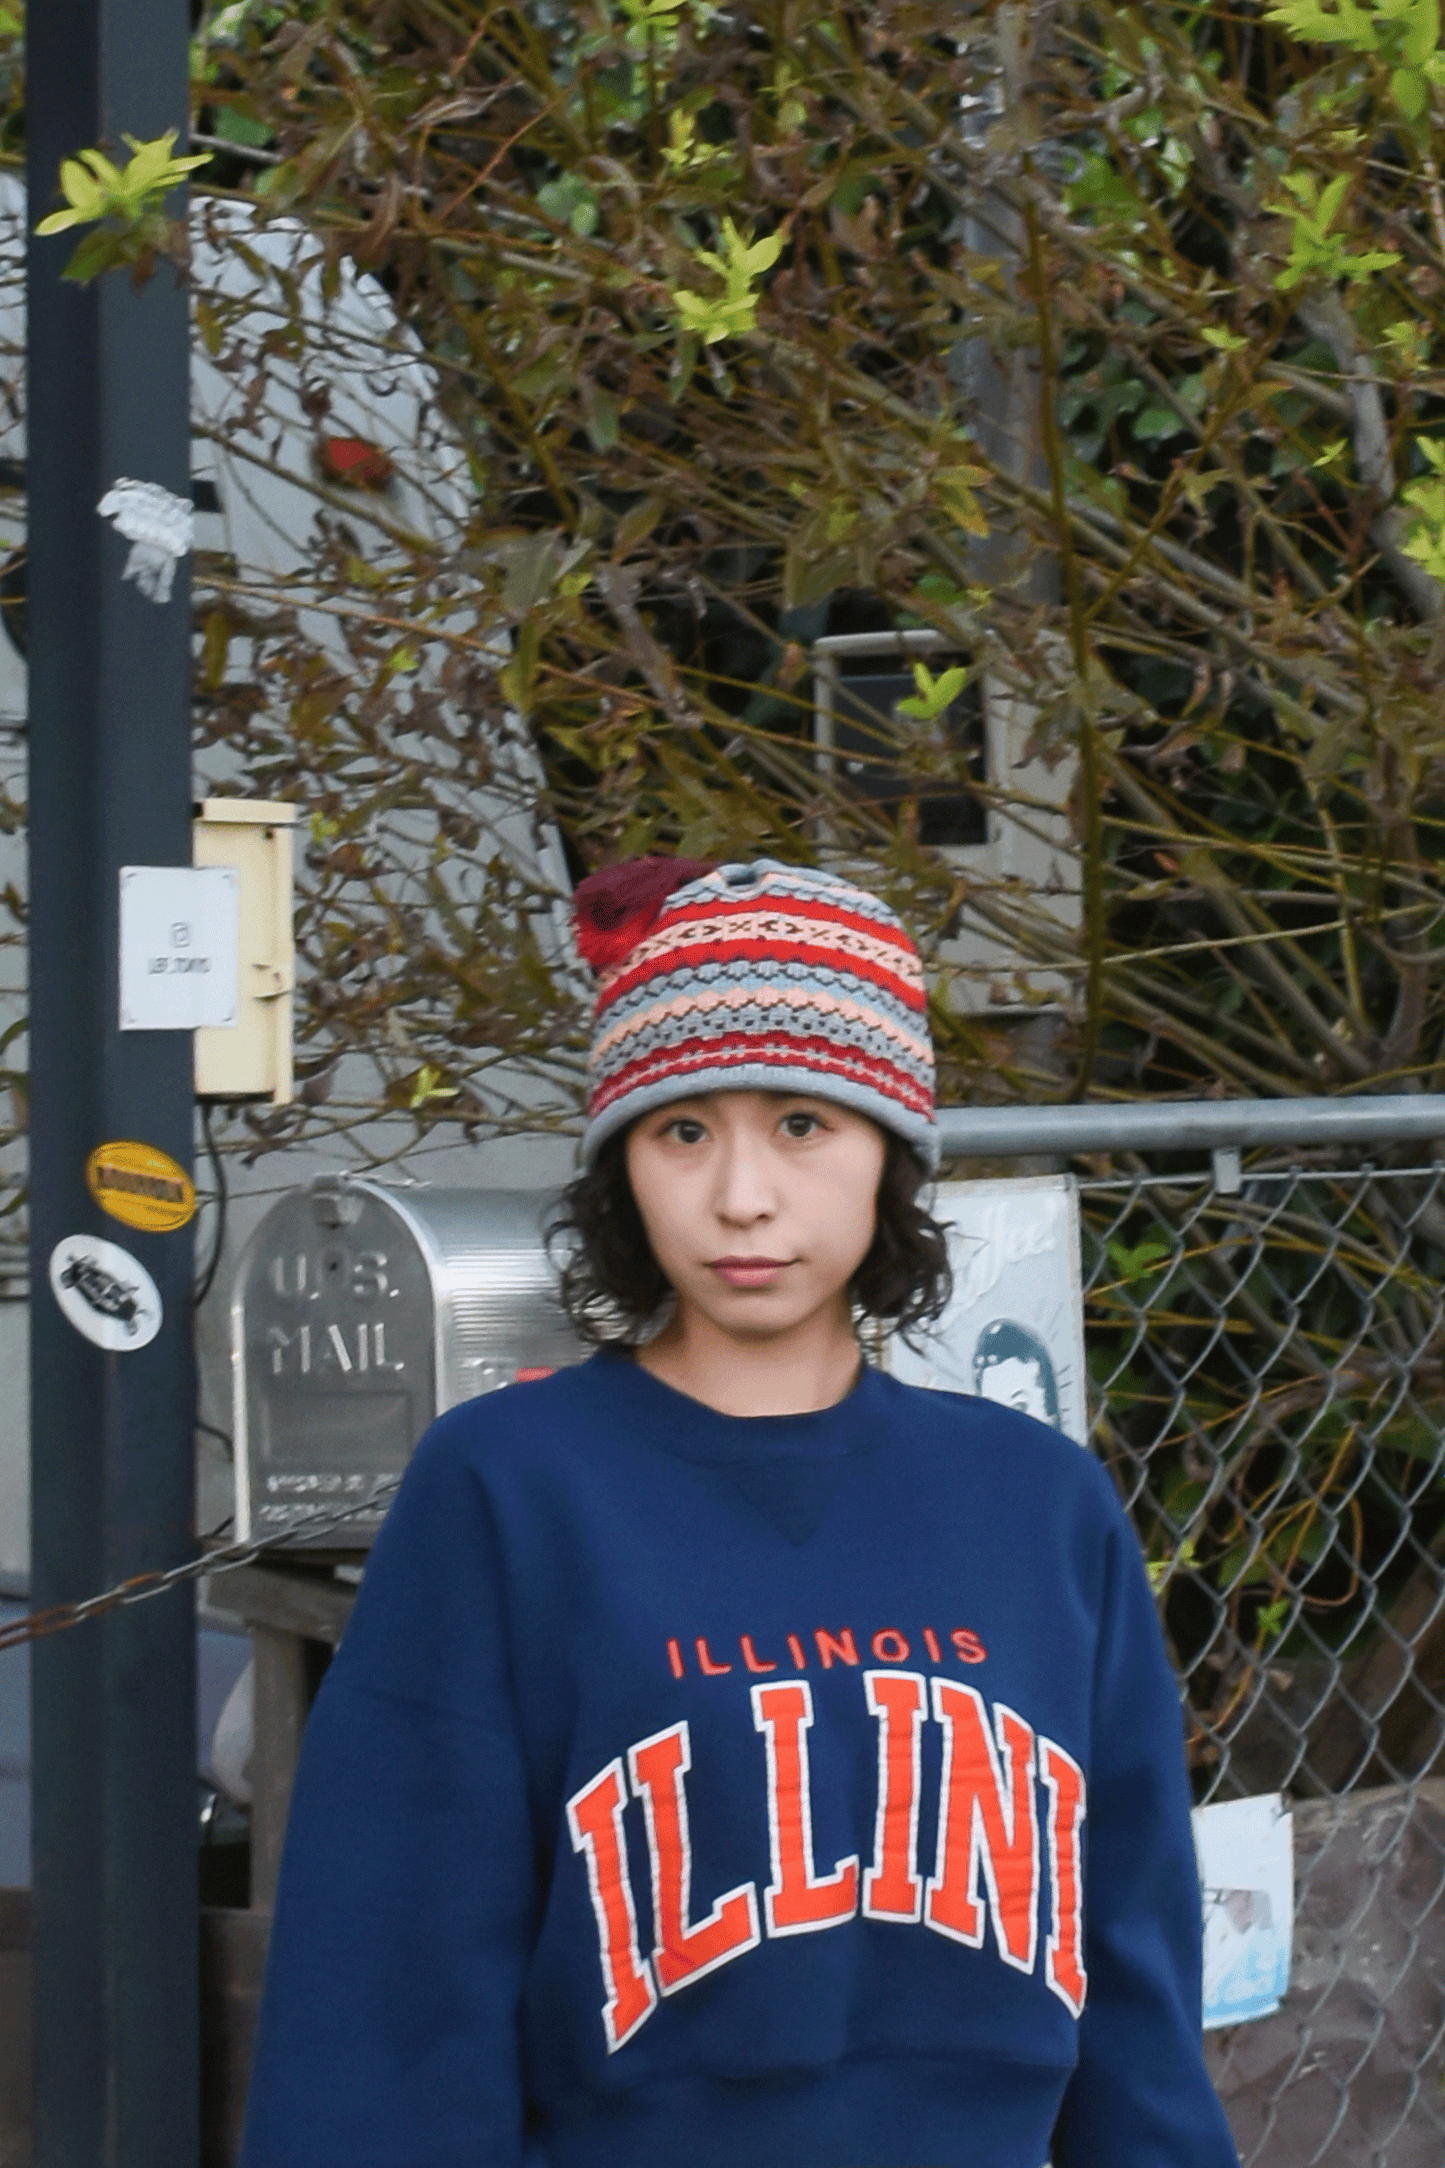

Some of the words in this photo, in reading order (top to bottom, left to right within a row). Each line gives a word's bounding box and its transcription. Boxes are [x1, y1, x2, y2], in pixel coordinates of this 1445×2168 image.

[268, 1321, 405, 1375] MAIL
[667, 1627, 988, 1679] ILLINOIS
[565, 1669, 1088, 2056] ILLINI
